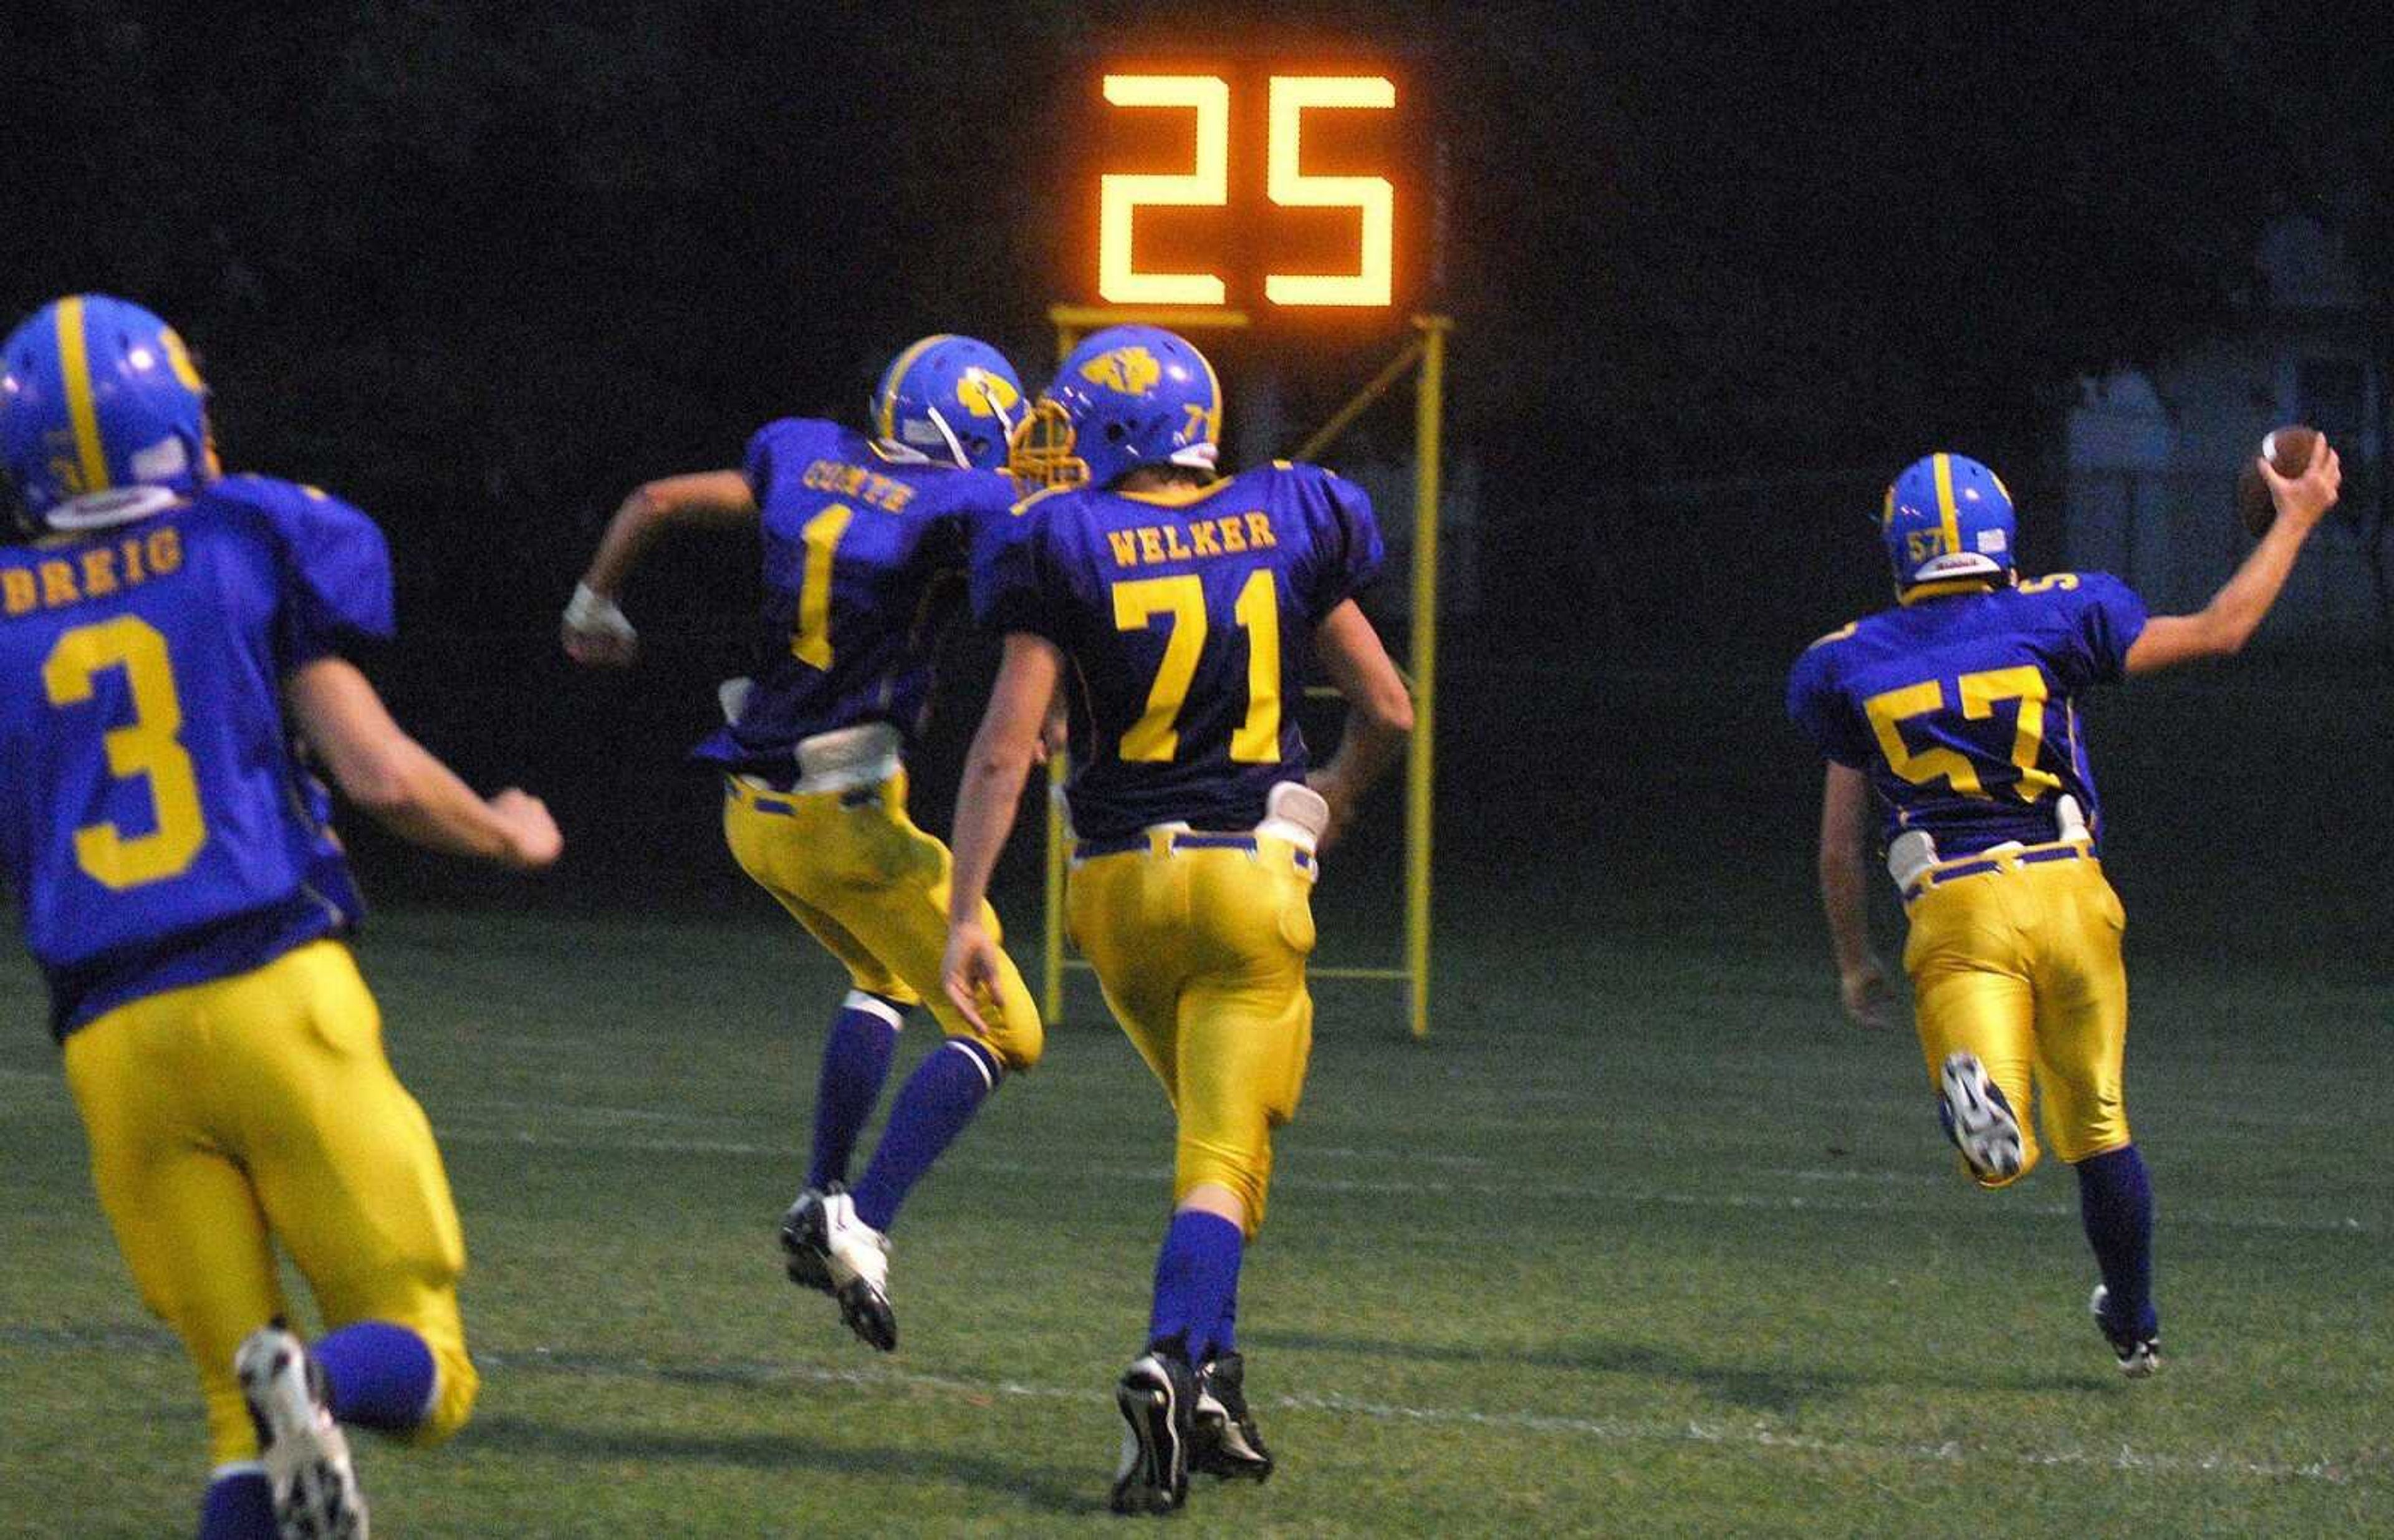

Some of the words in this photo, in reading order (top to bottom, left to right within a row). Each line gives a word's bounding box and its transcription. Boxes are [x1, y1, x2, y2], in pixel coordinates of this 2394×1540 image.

[1099, 75, 1395, 306] 25
[790, 503, 852, 672] 1
[1108, 513, 1276, 568] WELKER
[42, 615, 208, 892] 3
[1112, 568, 1282, 763] 71
[1864, 665, 2062, 804] 57
